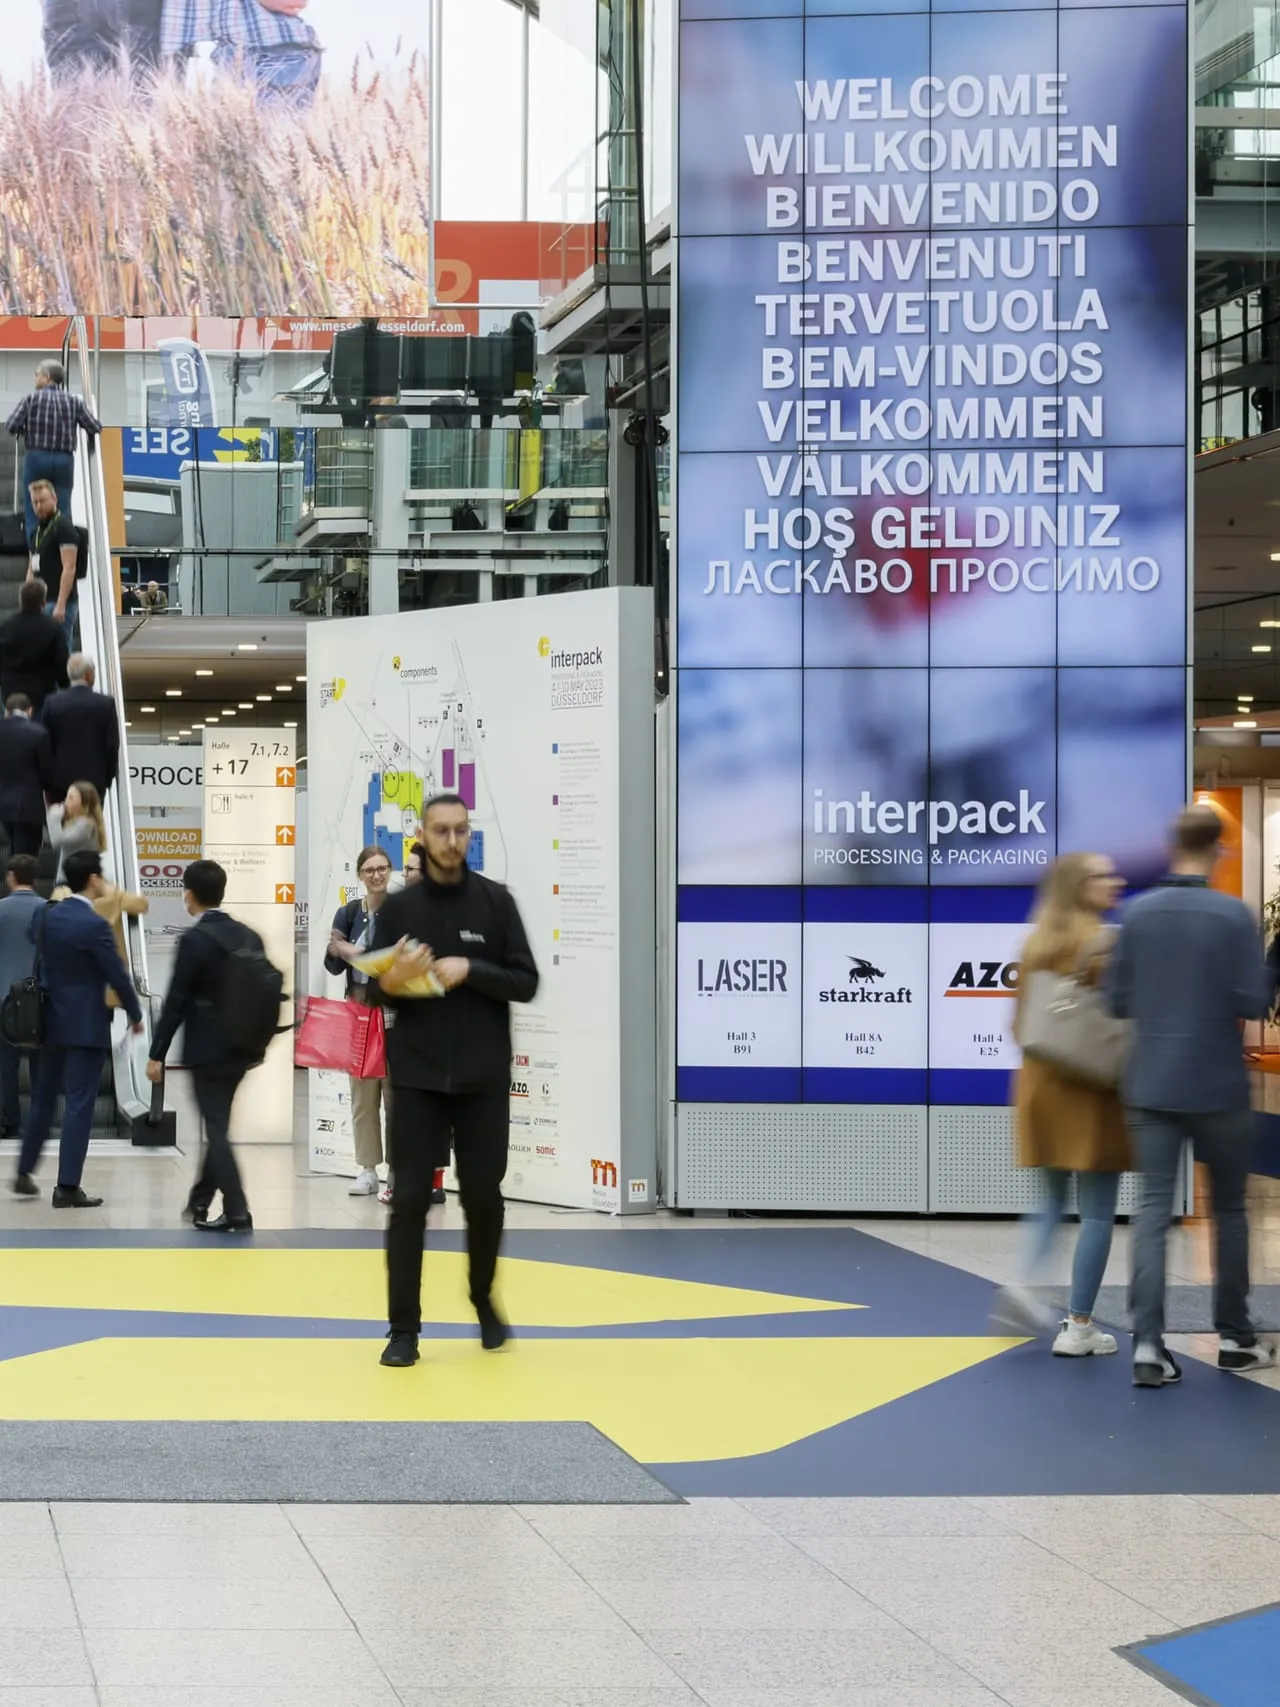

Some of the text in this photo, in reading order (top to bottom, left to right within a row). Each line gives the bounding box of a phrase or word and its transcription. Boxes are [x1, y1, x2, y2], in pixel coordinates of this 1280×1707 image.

[796, 73, 1069, 121] WELCOME
[744, 125, 1118, 176] WILLKOMMEN
[766, 179, 1100, 229] BIENVENIDO
[777, 235, 1087, 284] BENVENUTI
[755, 288, 1109, 337] TERVETUOLA
[290, 320, 465, 333] www.messeesseldorf.com
[762, 342, 1103, 390] BEM-VINDOS
[758, 395, 1103, 443] VELKOMMEN
[756, 444, 1104, 497] VÄLKOMMEN
[744, 504, 1121, 559] HOŞ GELDINIZ
[703, 556, 1160, 594] ЛАСКАВО ПРОСИМО
[551, 646, 603, 670] interpack
[400, 666, 437, 679] components
[212, 742, 230, 750] Halle
[228, 760, 249, 775] 17
[814, 789, 1048, 844] interpack
[135, 832, 197, 842] OWNLOAD
[147, 844, 199, 854] MAGAZIN
[814, 849, 1048, 864] PROCESSING & PACKAGING
[139, 879, 184, 888] OCESSIN
[698, 959, 787, 992] LASER
[819, 987, 912, 1003] starkraft
[727, 1032, 756, 1041] Hall 3
[845, 1033, 866, 1042] Hall
[973, 1034, 1003, 1043] Hall 4
[734, 1045, 752, 1054] B91
[856, 1046, 875, 1055] B42
